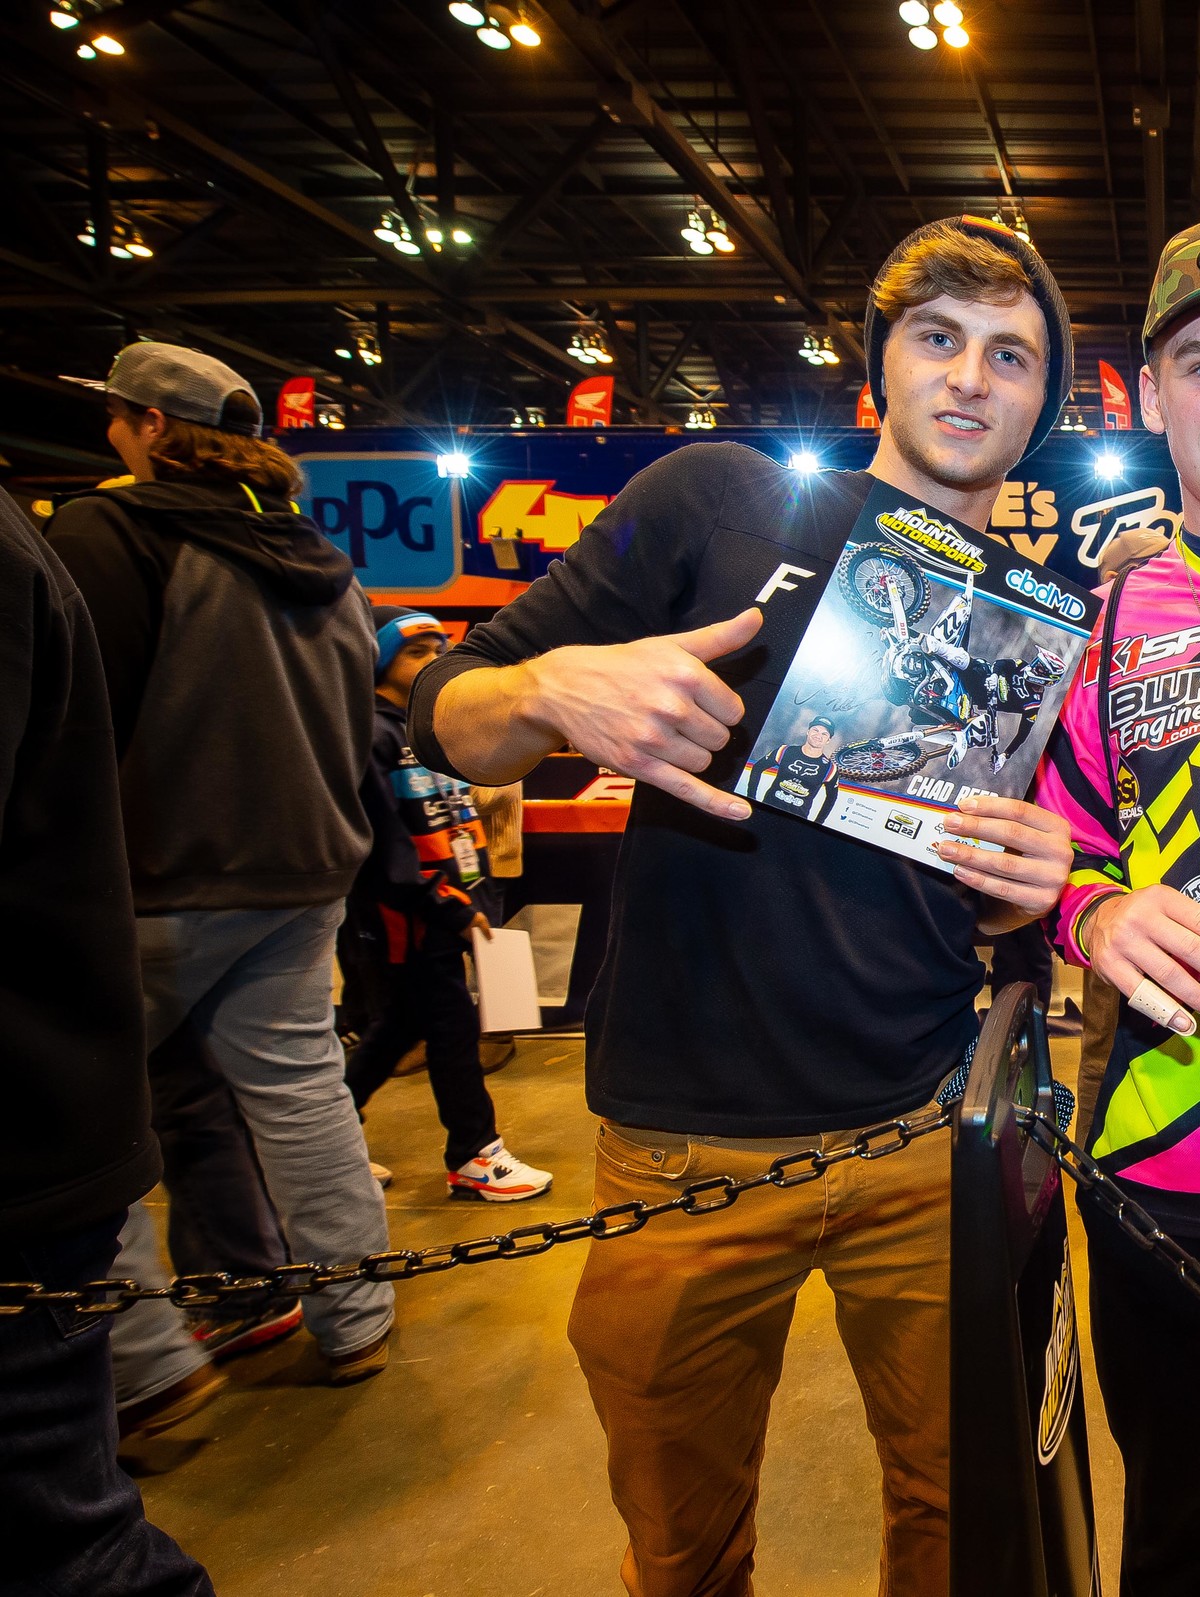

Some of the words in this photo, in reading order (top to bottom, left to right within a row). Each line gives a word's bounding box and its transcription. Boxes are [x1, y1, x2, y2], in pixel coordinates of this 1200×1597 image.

[879, 512, 986, 574] MOTORSPORTS
[893, 507, 980, 558] MOUNTAIN
[1005, 568, 1087, 621] cbdMD
[906, 775, 956, 803] CHAD
[886, 821, 900, 833] CR
[901, 824, 914, 837] 22
